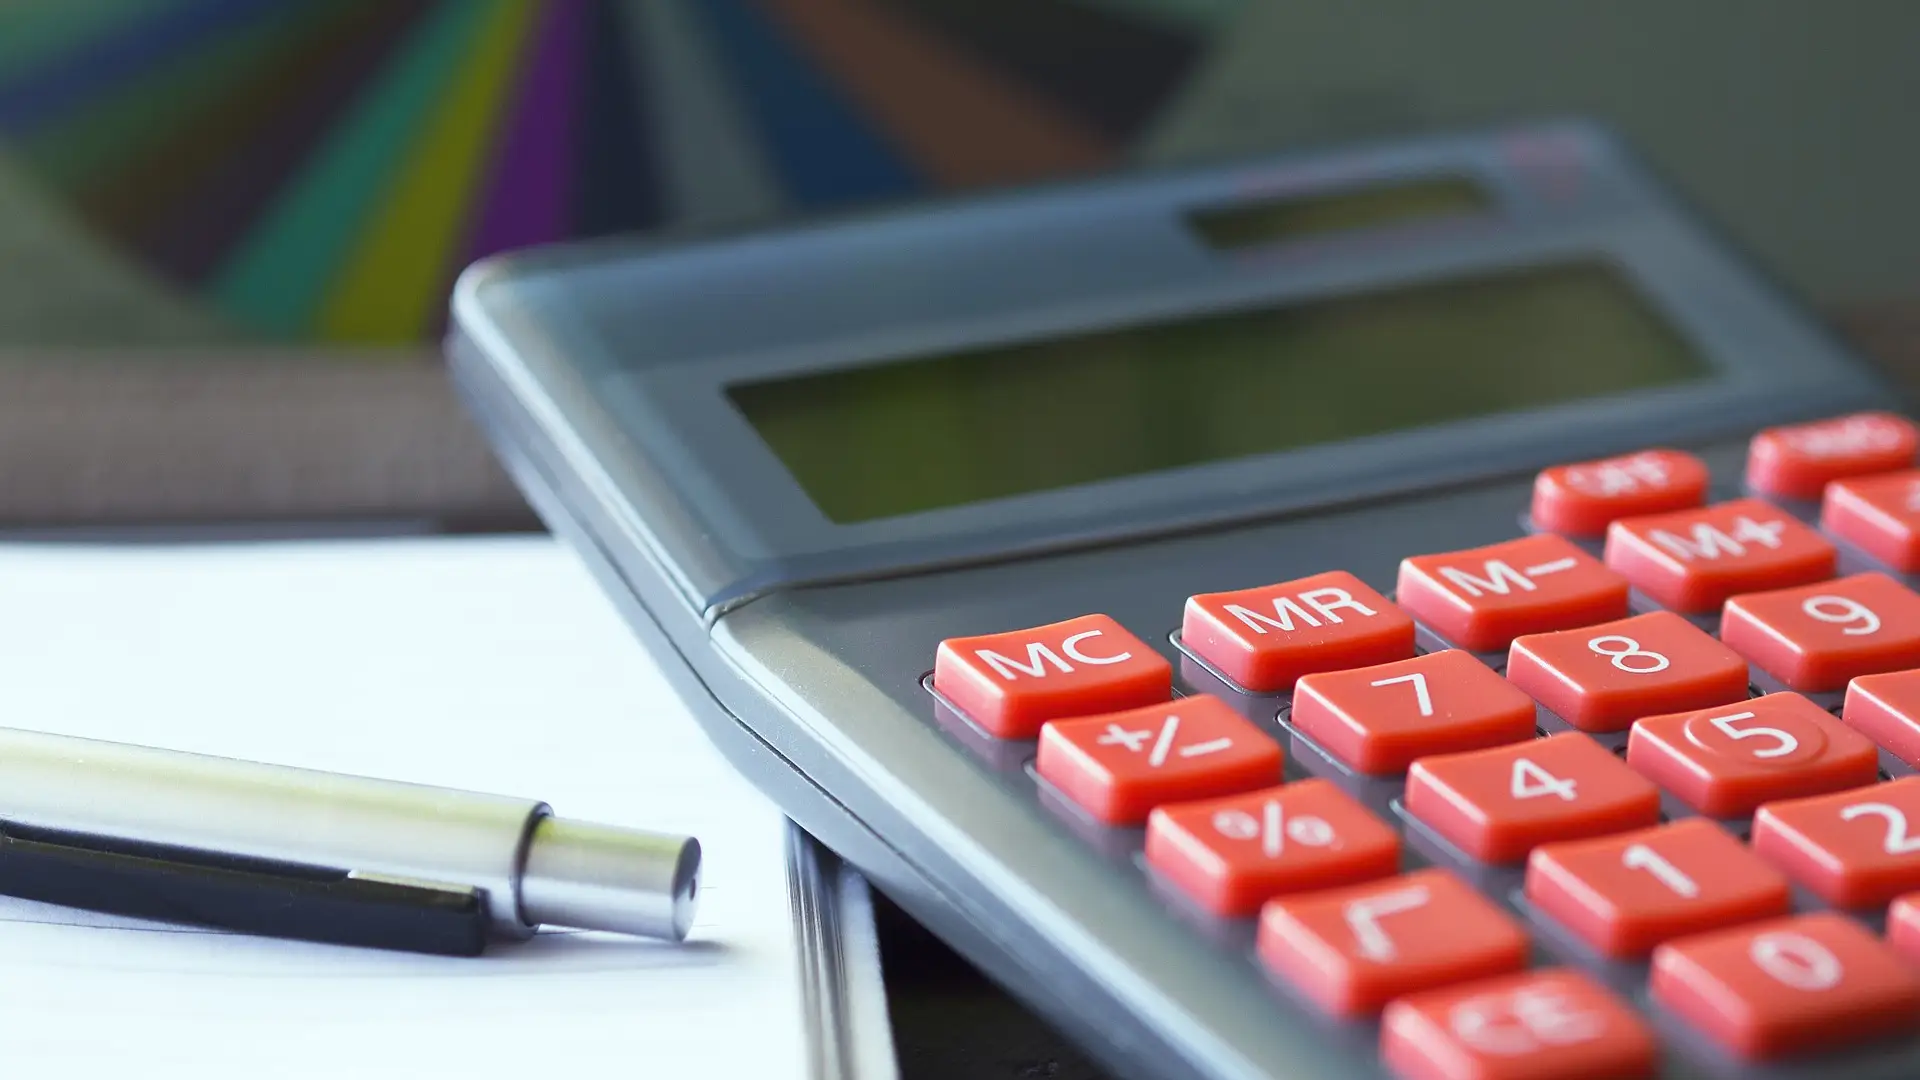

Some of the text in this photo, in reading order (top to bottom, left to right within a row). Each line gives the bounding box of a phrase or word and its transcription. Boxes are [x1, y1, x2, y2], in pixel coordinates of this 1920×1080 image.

[1648, 515, 1786, 561] M+
[1223, 587, 1377, 634] MR
[1801, 595, 1882, 636] 9
[974, 629, 1132, 681] MC
[1587, 634, 1671, 674] 8
[1370, 672, 1434, 717] 7
[1709, 711, 1799, 758] 5
[1510, 757, 1579, 802] 4
[1212, 799, 1337, 859] %
[1840, 803, 1920, 854] 2
[1621, 842, 1699, 899] 1
[1749, 929, 1844, 991] 0
